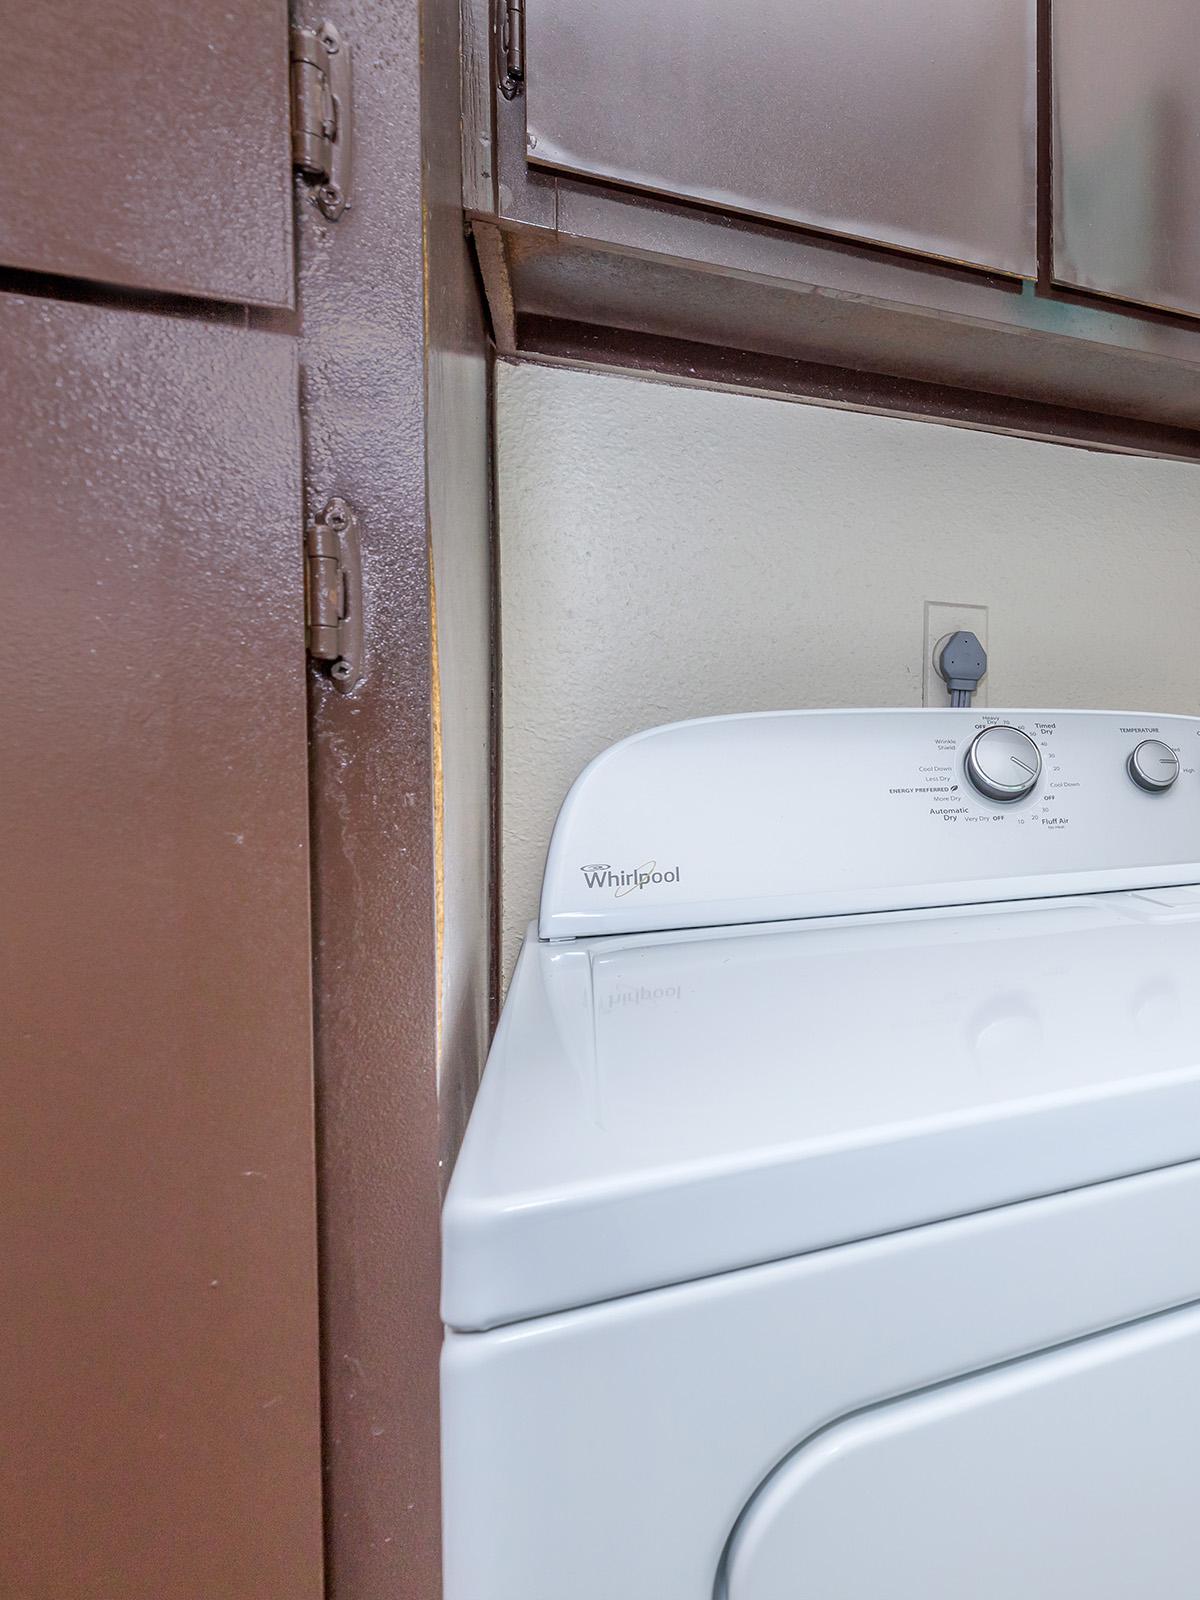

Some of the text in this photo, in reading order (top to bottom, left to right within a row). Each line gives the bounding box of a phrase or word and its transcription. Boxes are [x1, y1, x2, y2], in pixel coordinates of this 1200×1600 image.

[929, 807, 969, 815] Automatic
[943, 814, 958, 822] Dry
[583, 866, 681, 890] Whirlpool
